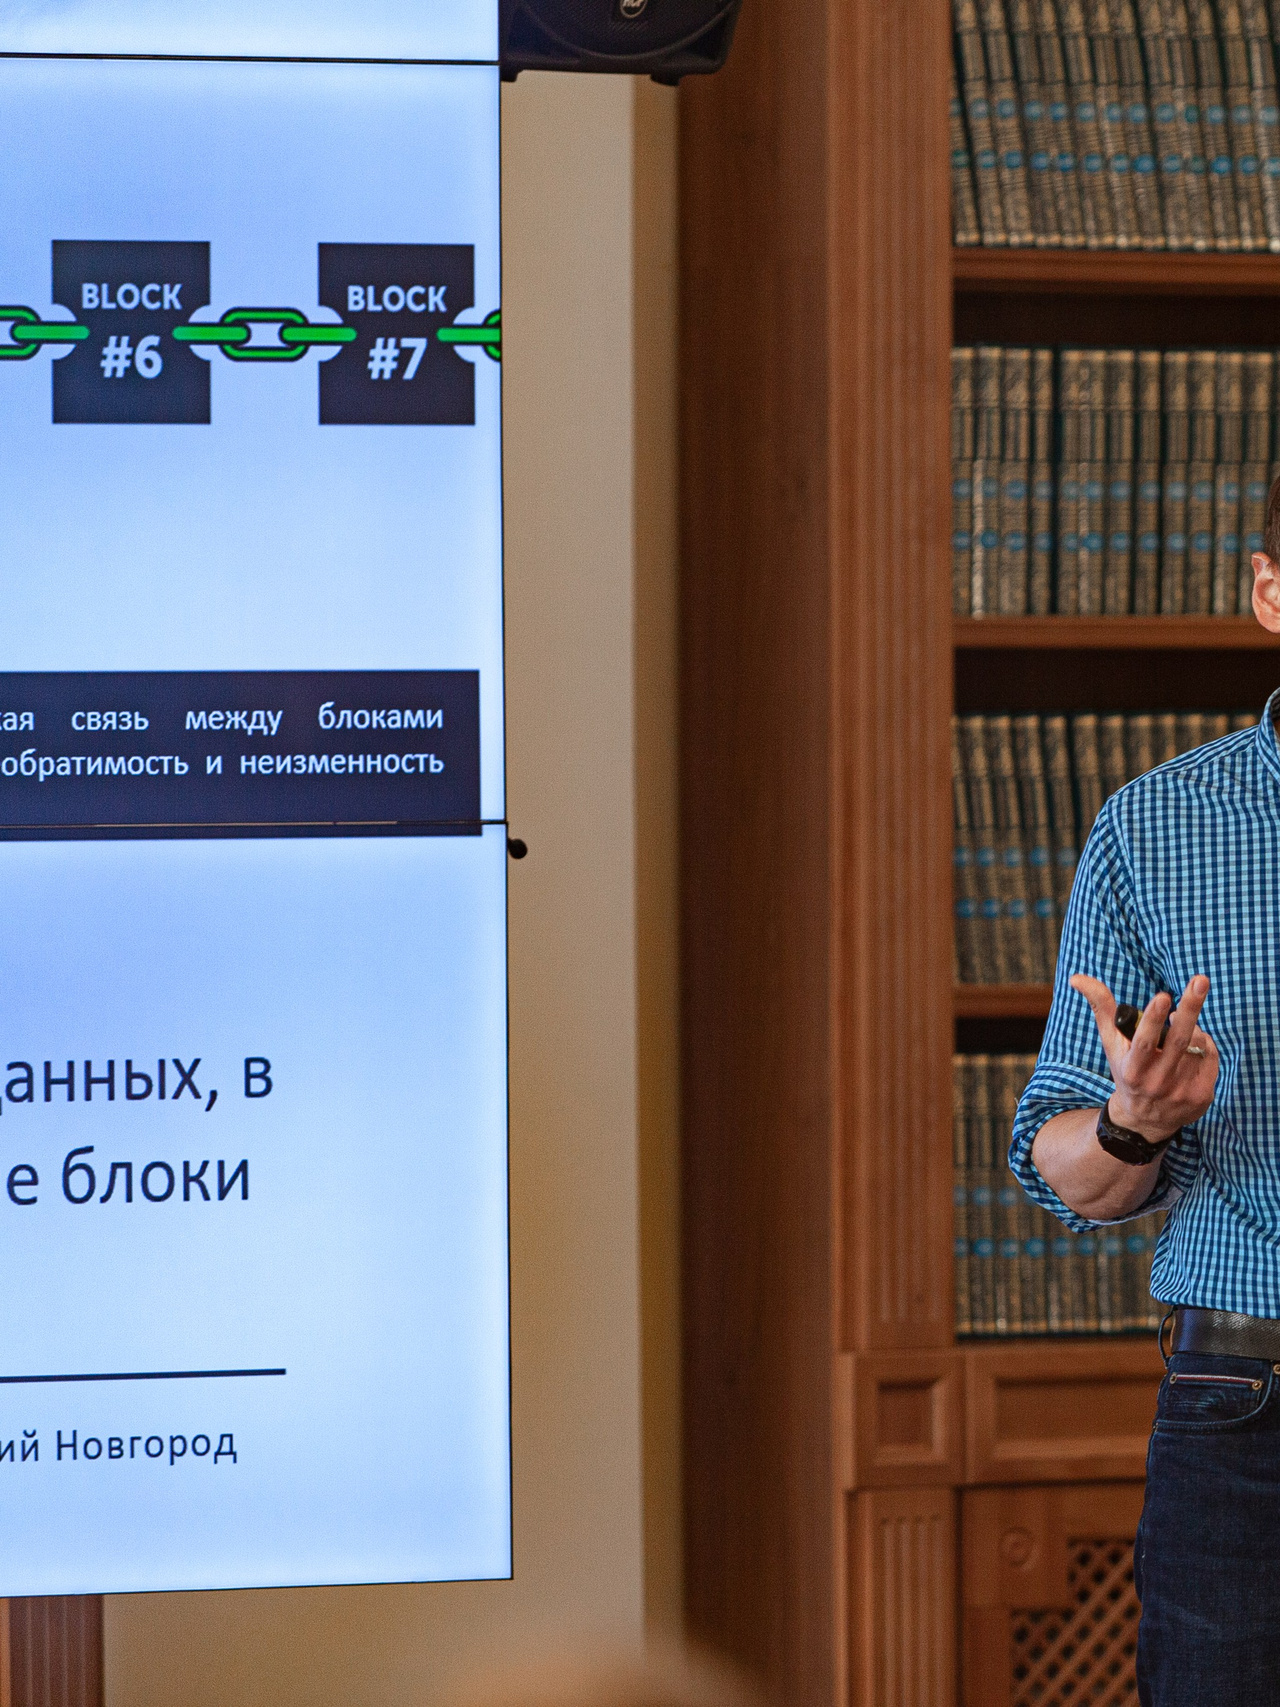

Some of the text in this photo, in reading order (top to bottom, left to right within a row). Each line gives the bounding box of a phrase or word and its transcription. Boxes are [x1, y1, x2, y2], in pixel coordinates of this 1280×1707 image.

[81, 283, 182, 310] BLOCK
[347, 285, 447, 312] BLOCK
[100, 335, 163, 379] #6
[367, 337, 428, 380] #7
[0, 701, 443, 736] ая связь между блоками
[1, 748, 444, 782] обратимость и неизменность
[0, 1056, 273, 1112] анных, в
[61, 1145, 249, 1205] блоки
[56, 1429, 238, 1467] Новгород
